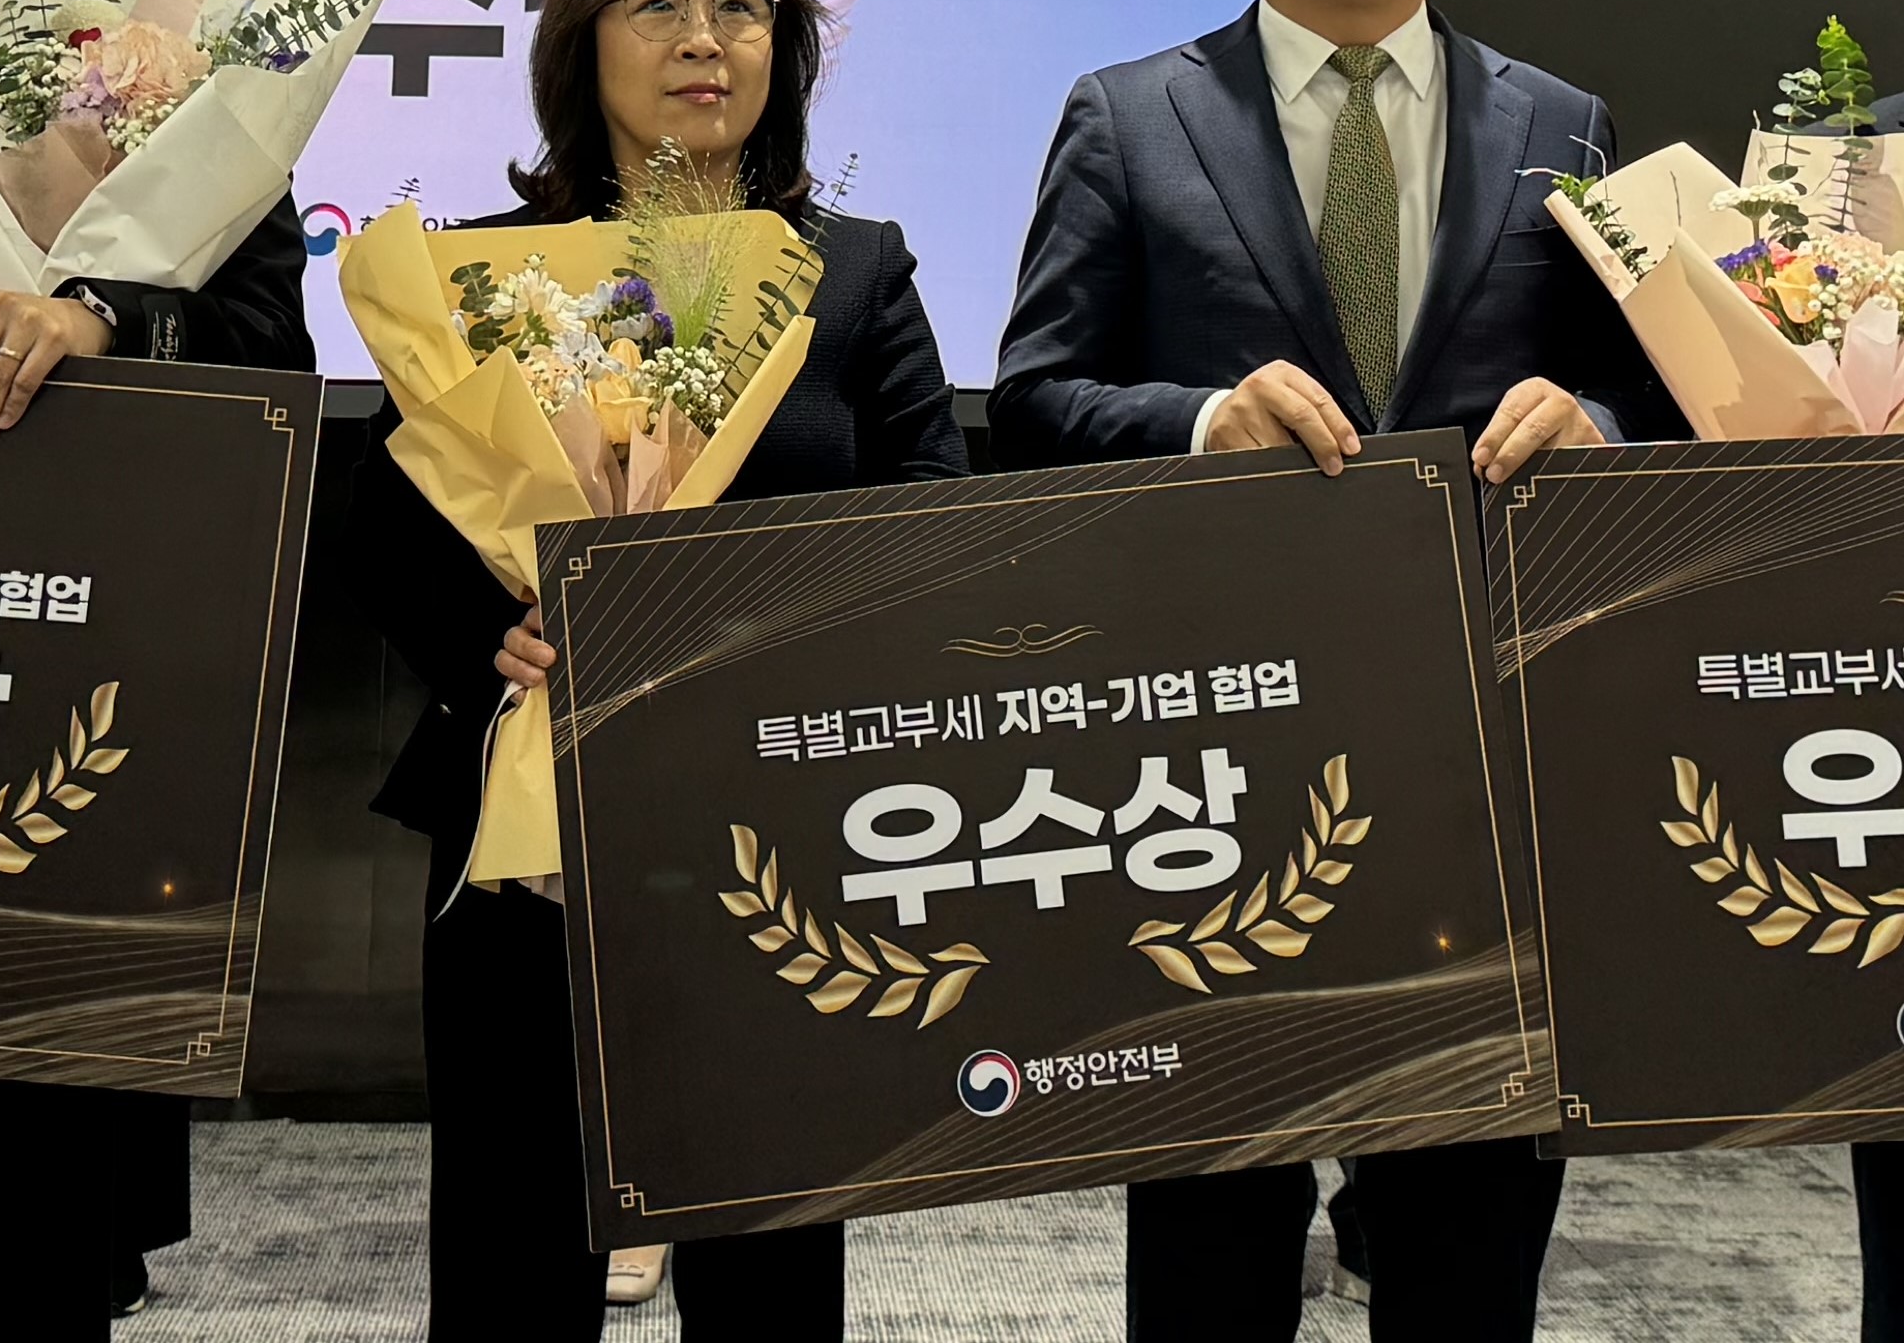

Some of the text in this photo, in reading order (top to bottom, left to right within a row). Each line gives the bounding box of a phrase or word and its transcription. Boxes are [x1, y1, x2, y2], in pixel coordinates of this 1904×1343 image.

[756, 659, 1300, 762] 특별교부세 지역-기업 협업
[841, 747, 1248, 926] 우수상
[1023, 1042, 1183, 1094] 행정안전부
